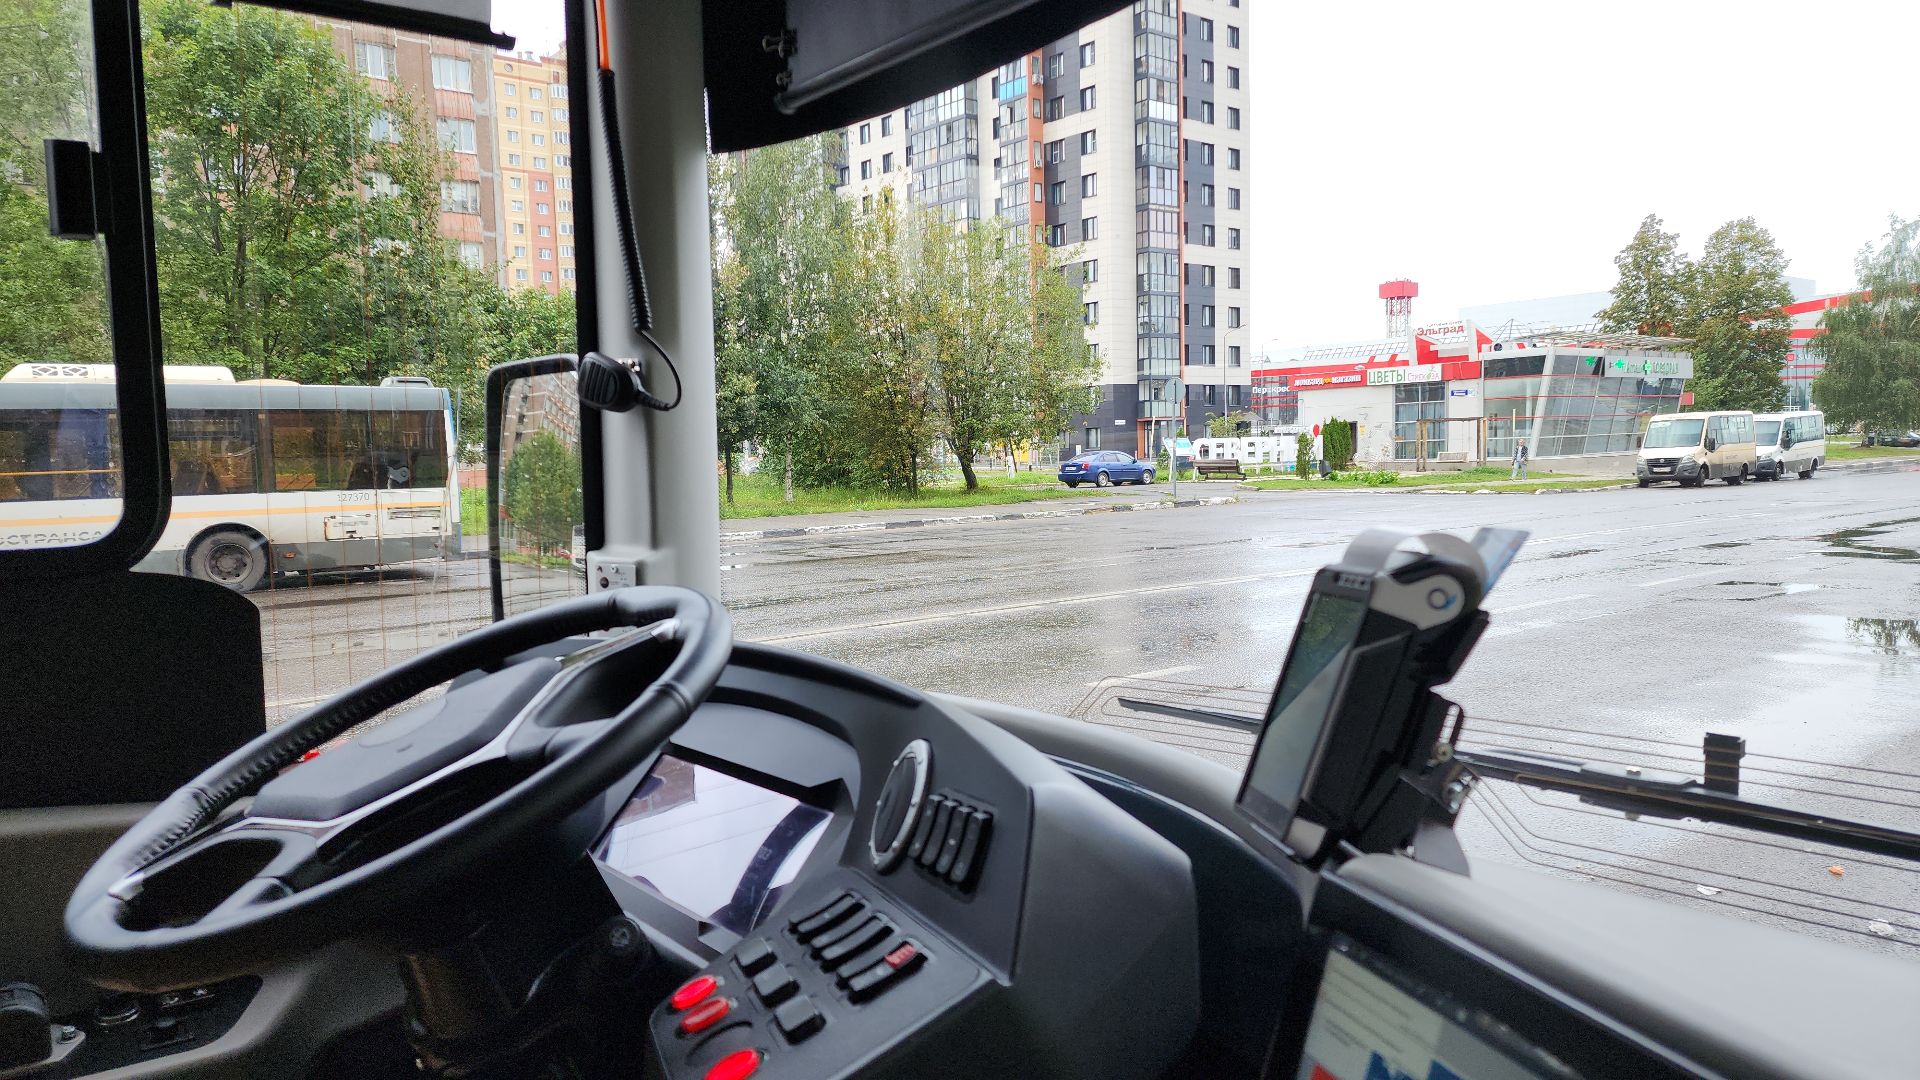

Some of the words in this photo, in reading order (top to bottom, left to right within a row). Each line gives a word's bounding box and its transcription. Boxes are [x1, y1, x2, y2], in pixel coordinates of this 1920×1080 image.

[1417, 325, 1464, 336] Эльград
[1369, 369, 1406, 384] ЦВЕТЫ
[337, 493, 370, 502] 127370
